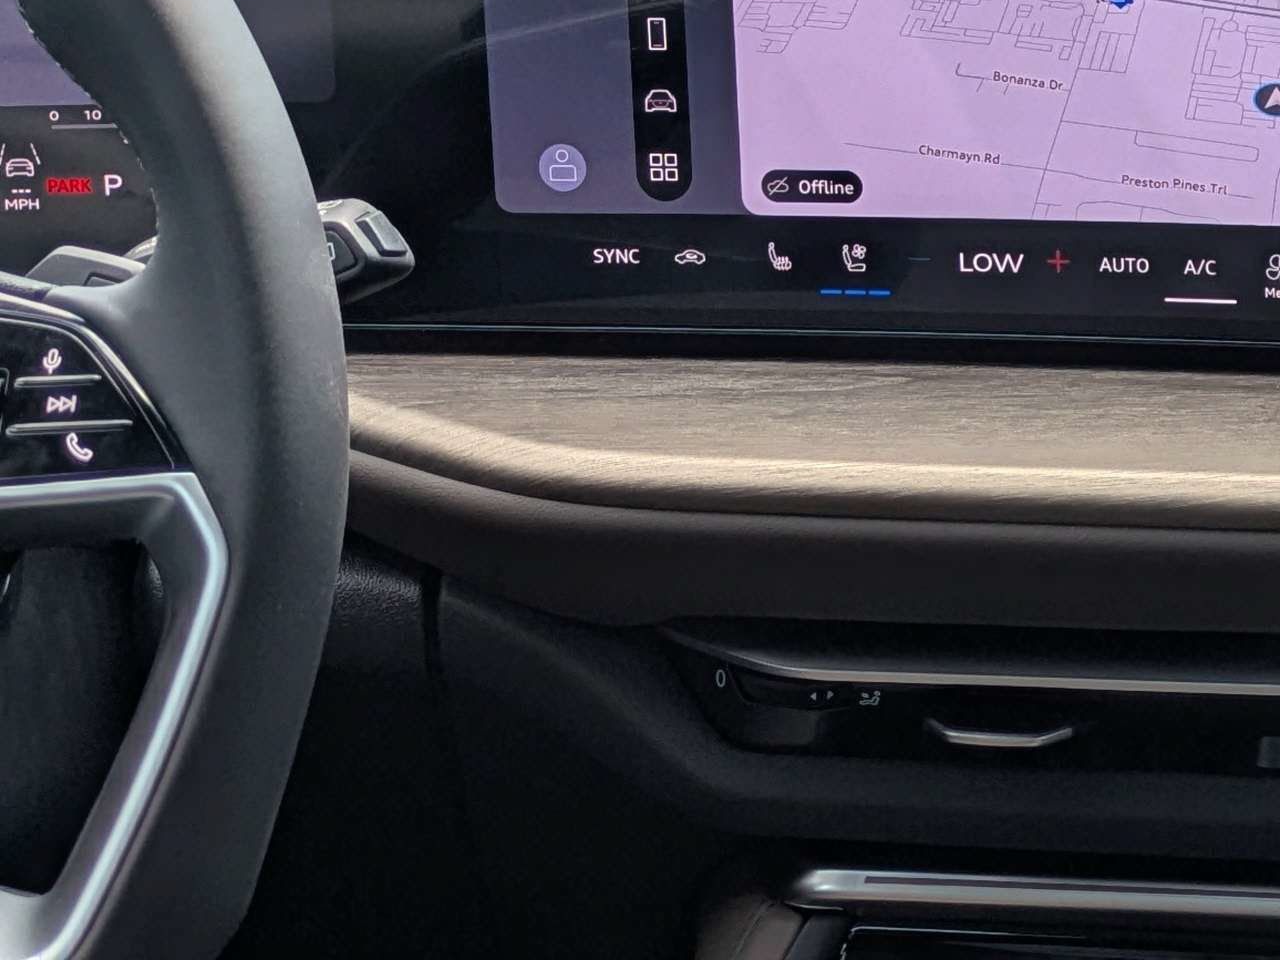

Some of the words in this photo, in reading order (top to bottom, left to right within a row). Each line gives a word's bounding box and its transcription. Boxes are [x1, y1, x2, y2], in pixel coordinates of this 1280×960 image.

[993, 70, 1045, 89] Bonanza
[1049, 79, 1064, 91] Dr
[48, 109, 60, 121] 0
[84, 109, 102, 121] 10
[918, 144, 981, 164] Charmayn
[984, 152, 1001, 165] Rd
[47, 177, 93, 194] PARK
[103, 174, 123, 197] P
[798, 179, 855, 195] Offline
[1121, 174, 1169, 189] Preston
[1173, 178, 1206, 193] Pines
[1210, 183, 1228, 196] Trl
[4, 198, 41, 211] MPH
[592, 248, 641, 266] SYNC
[958, 252, 1025, 274] LOW
[1099, 256, 1150, 274] AUTO
[1183, 259, 1217, 276] A/C
